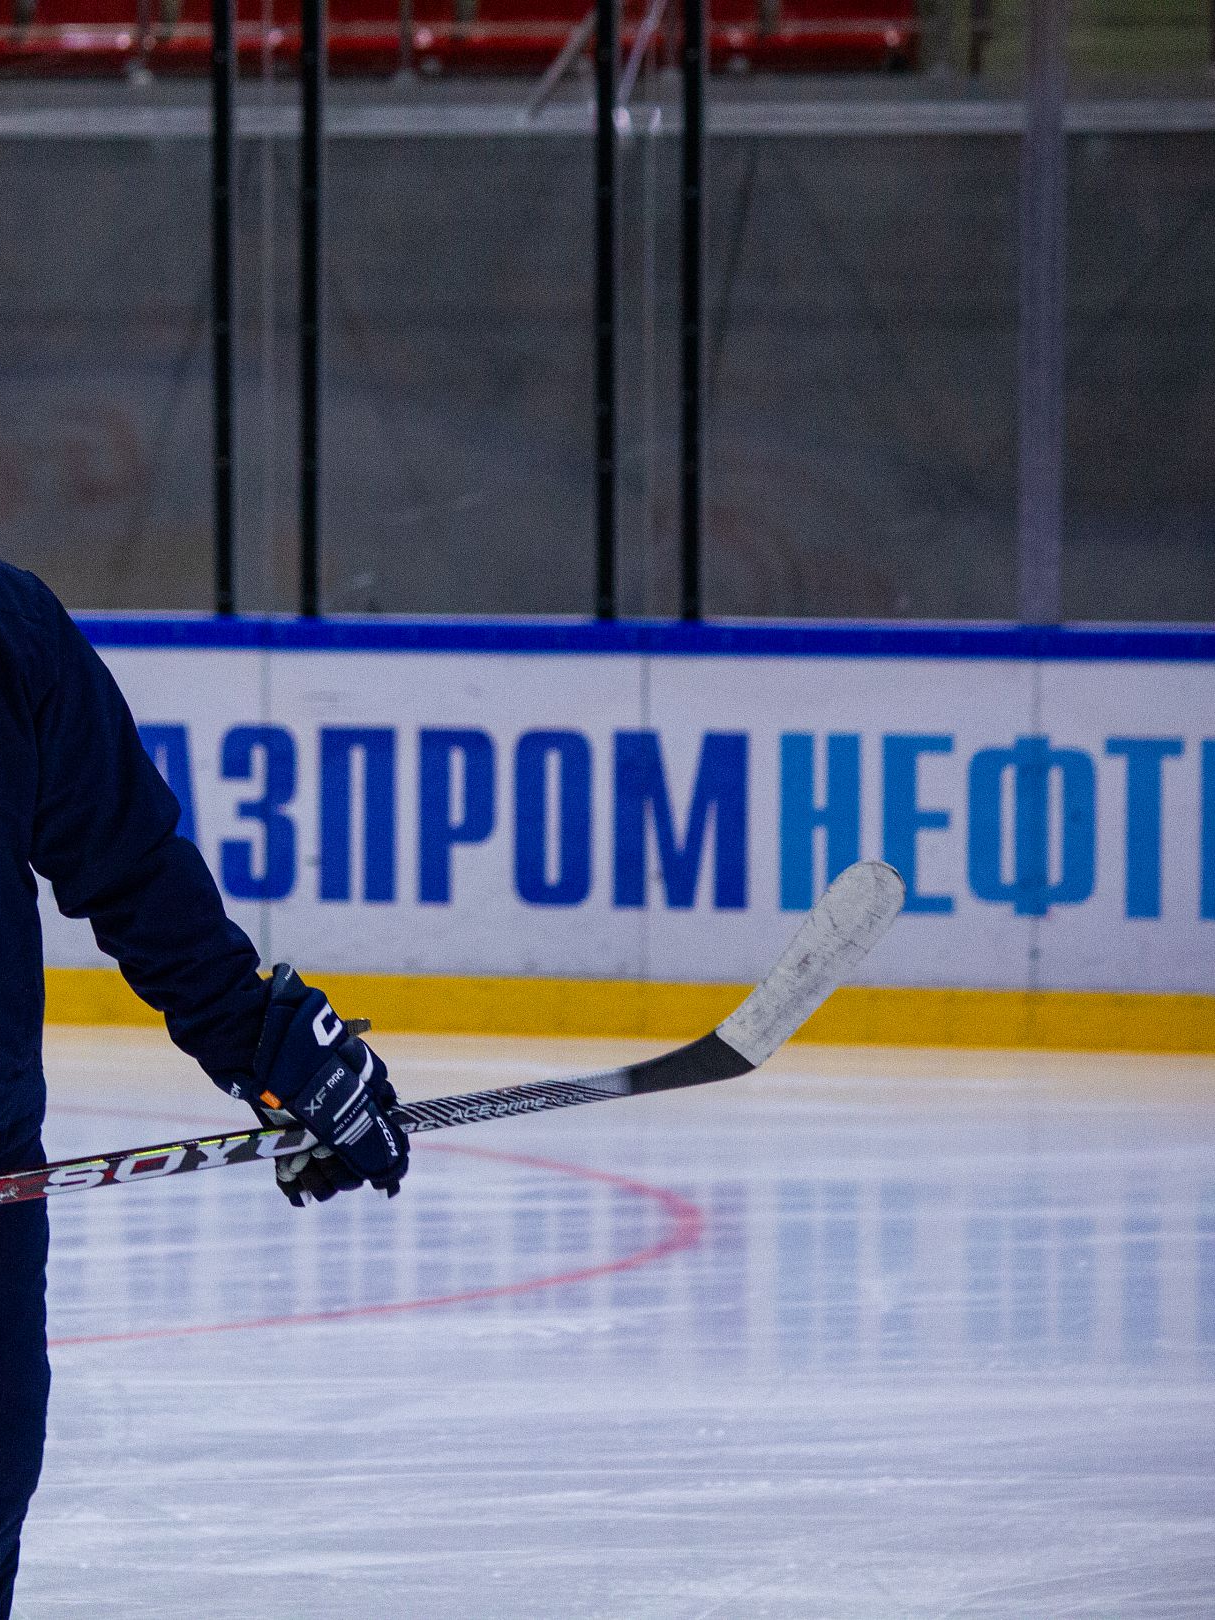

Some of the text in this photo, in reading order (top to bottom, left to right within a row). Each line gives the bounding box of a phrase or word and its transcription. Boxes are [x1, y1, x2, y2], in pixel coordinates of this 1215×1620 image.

[778, 730, 1215, 921] НЕФТ
[304, 1067, 345, 1117] XF PRO
[376, 1116, 399, 1157] CCM
